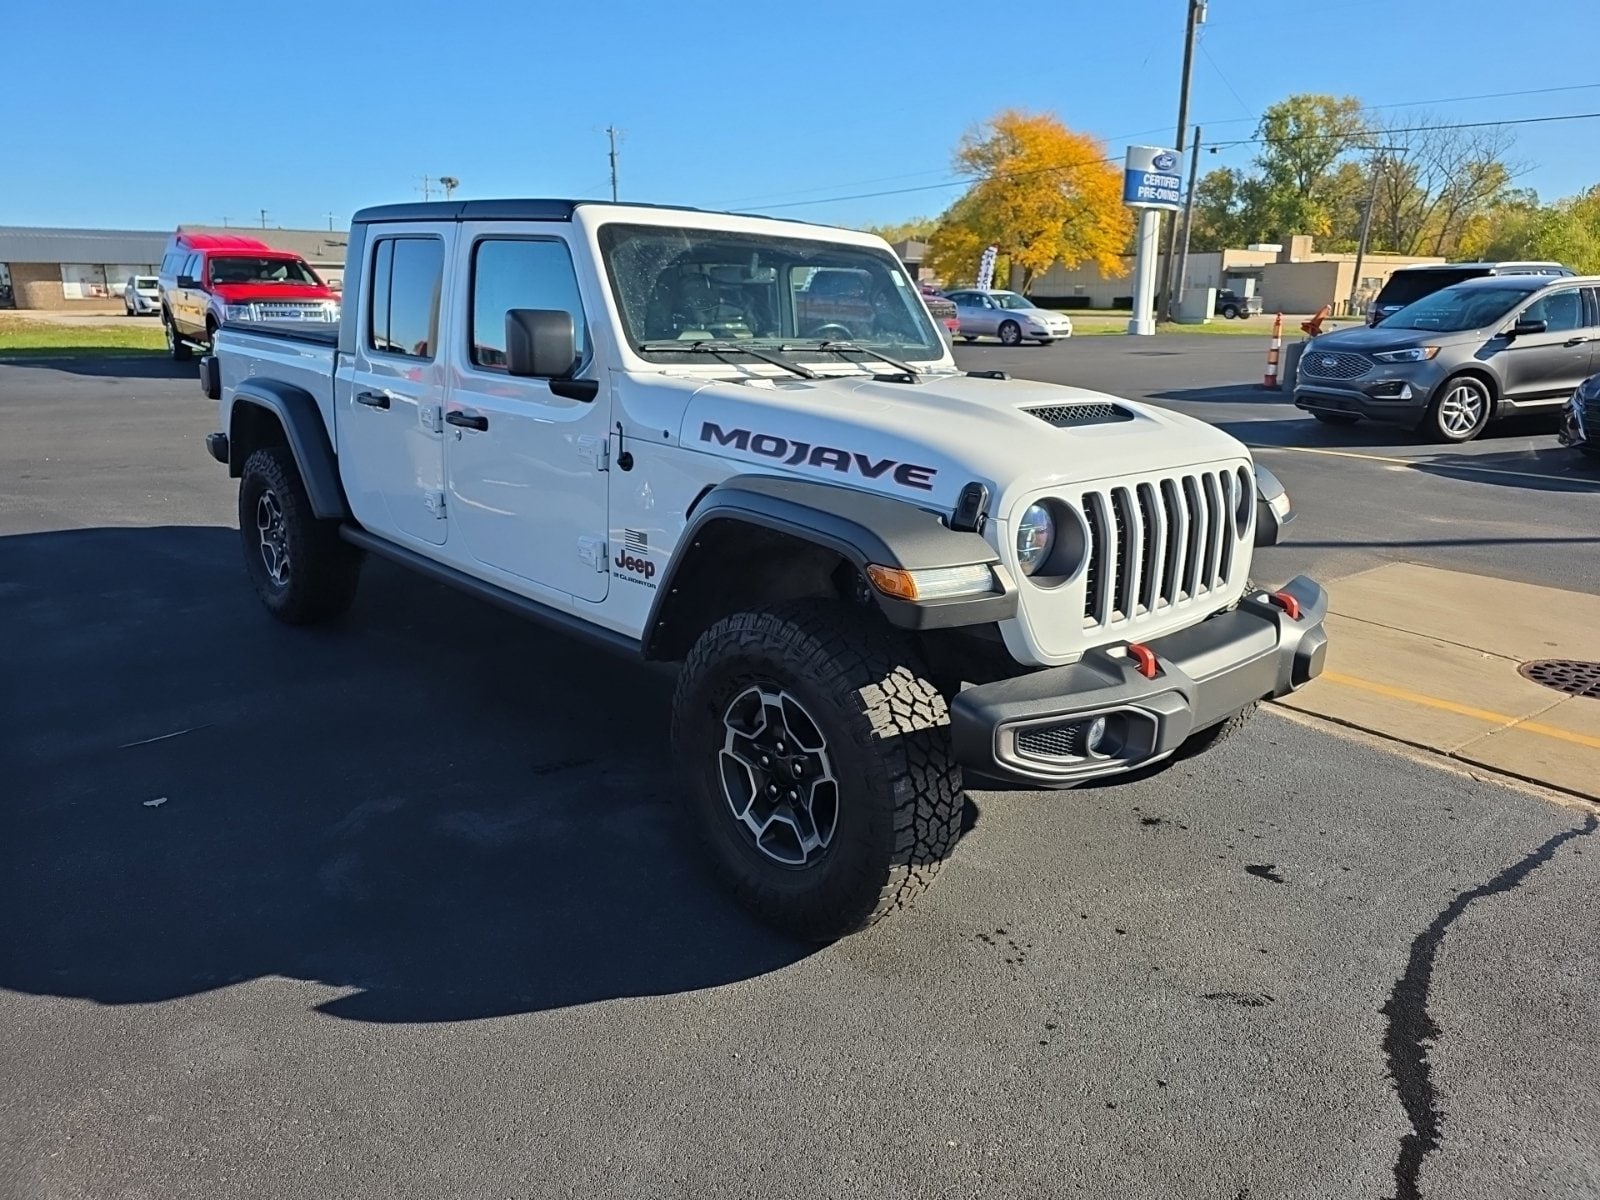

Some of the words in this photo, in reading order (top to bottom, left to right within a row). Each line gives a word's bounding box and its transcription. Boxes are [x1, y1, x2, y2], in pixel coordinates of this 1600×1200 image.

[1143, 173, 1179, 189] CERTIFIED
[1138, 186, 1179, 202] PRE-OWNED
[700, 421, 937, 491] MOJAVE
[615, 549, 655, 580] Jeep
[619, 573, 656, 589] GLADIATOR
